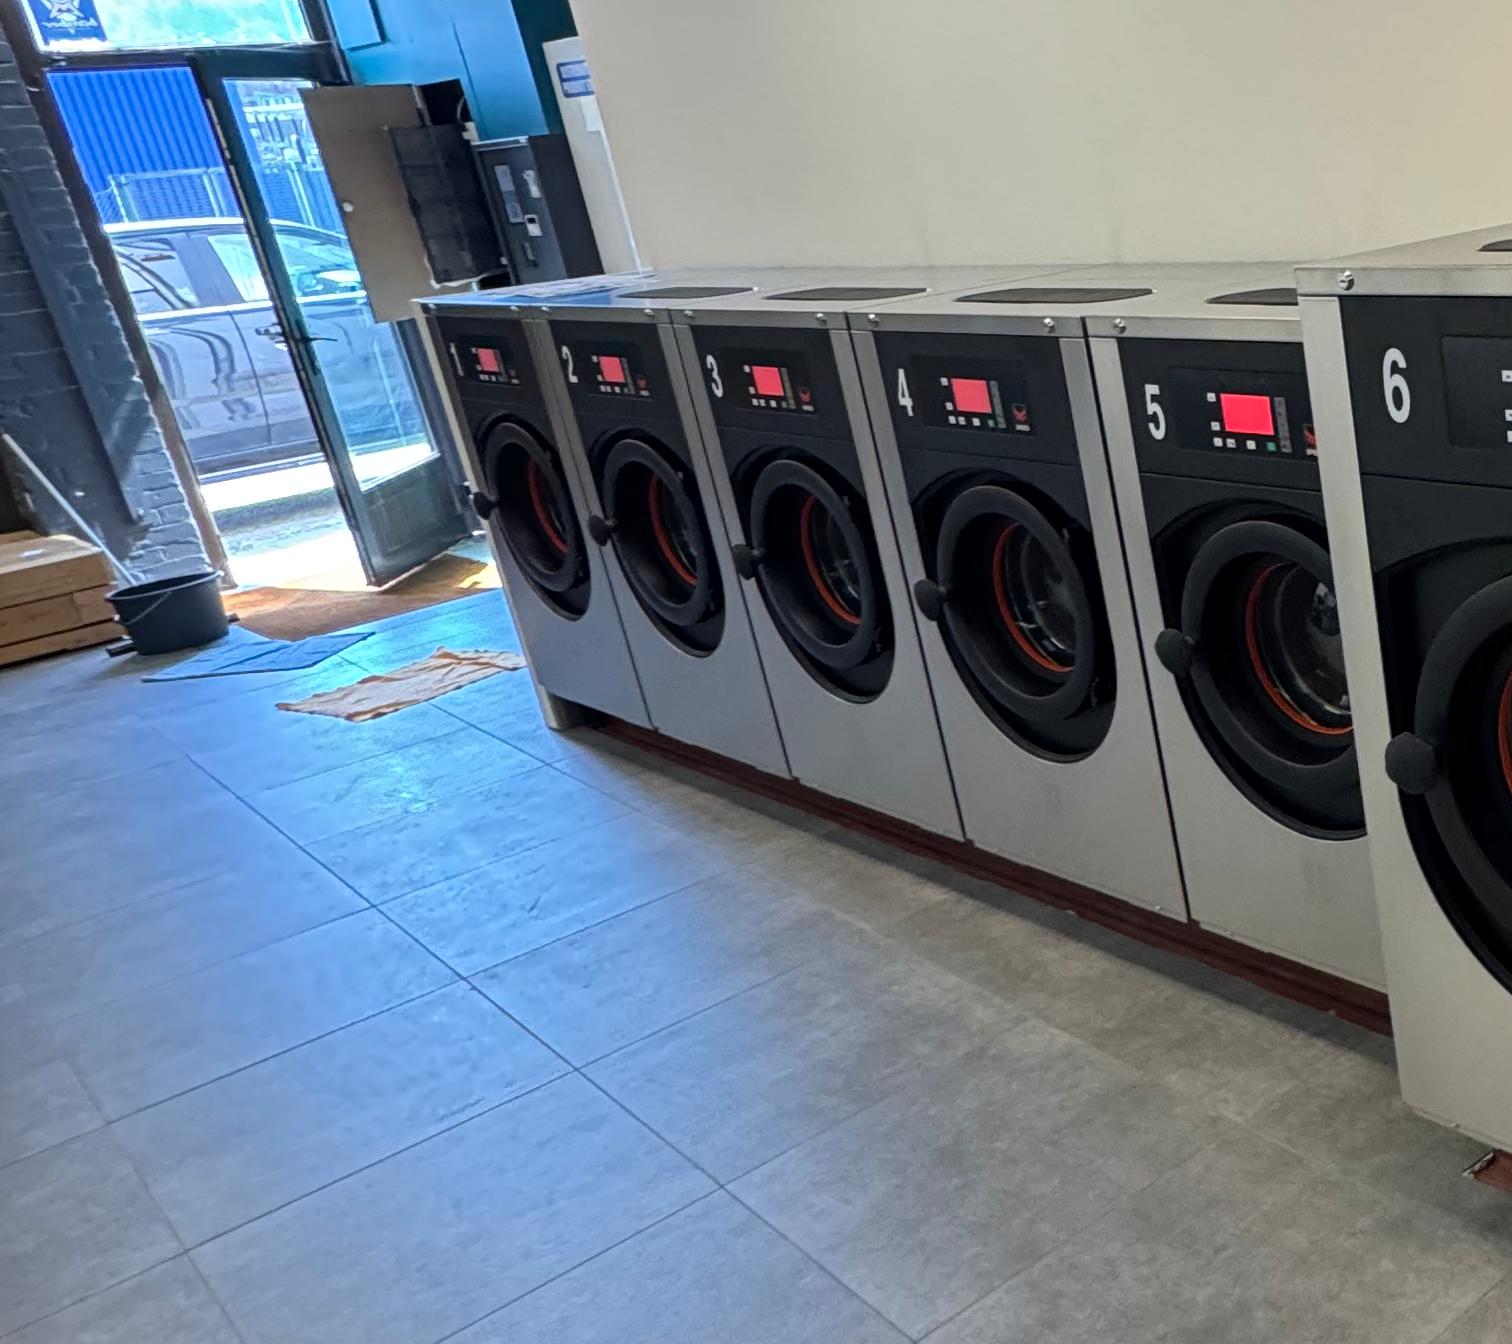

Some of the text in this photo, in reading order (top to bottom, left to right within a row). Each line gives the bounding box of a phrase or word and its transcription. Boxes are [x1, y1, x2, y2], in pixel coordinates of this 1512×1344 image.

[449, 342, 464, 376] 1
[561, 345, 579, 384] 2
[706, 354, 724, 398] 3
[897, 368, 914, 417] 4
[1382, 347, 1411, 423] 6
[1144, 383, 1167, 440] 5
